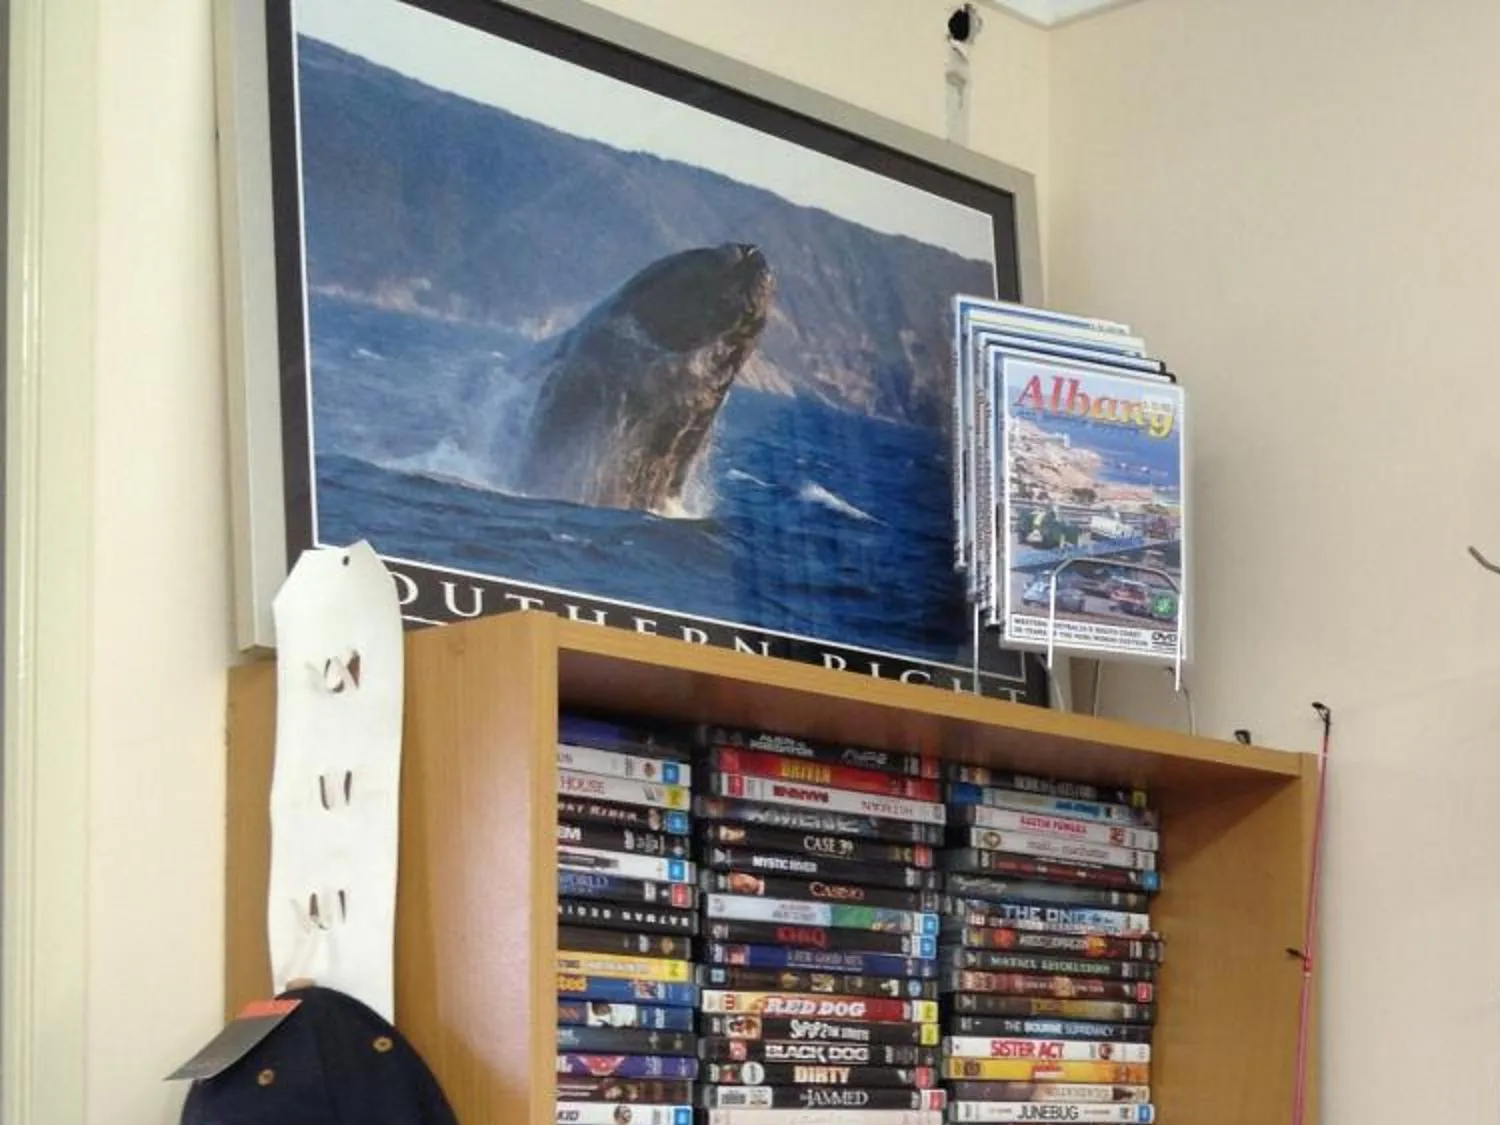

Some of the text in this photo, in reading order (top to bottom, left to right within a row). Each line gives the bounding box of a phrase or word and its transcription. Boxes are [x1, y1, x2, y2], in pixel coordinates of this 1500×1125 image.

[1014, 374, 1174, 438] Albany
[390, 570, 771, 658] OUTHERN
[804, 836, 833, 852] CASE
[752, 855, 788, 871] MYSTIC
[1002, 903, 1041, 920] THE
[765, 997, 867, 1018] RED DOG
[1004, 1020, 1021, 1032] THE
[765, 1045, 869, 1063] BLACK DOG
[990, 1039, 1065, 1059] SISTER ACT
[793, 1065, 851, 1084] DIRTY
[1017, 1104, 1078, 1120] JUNEBUG
